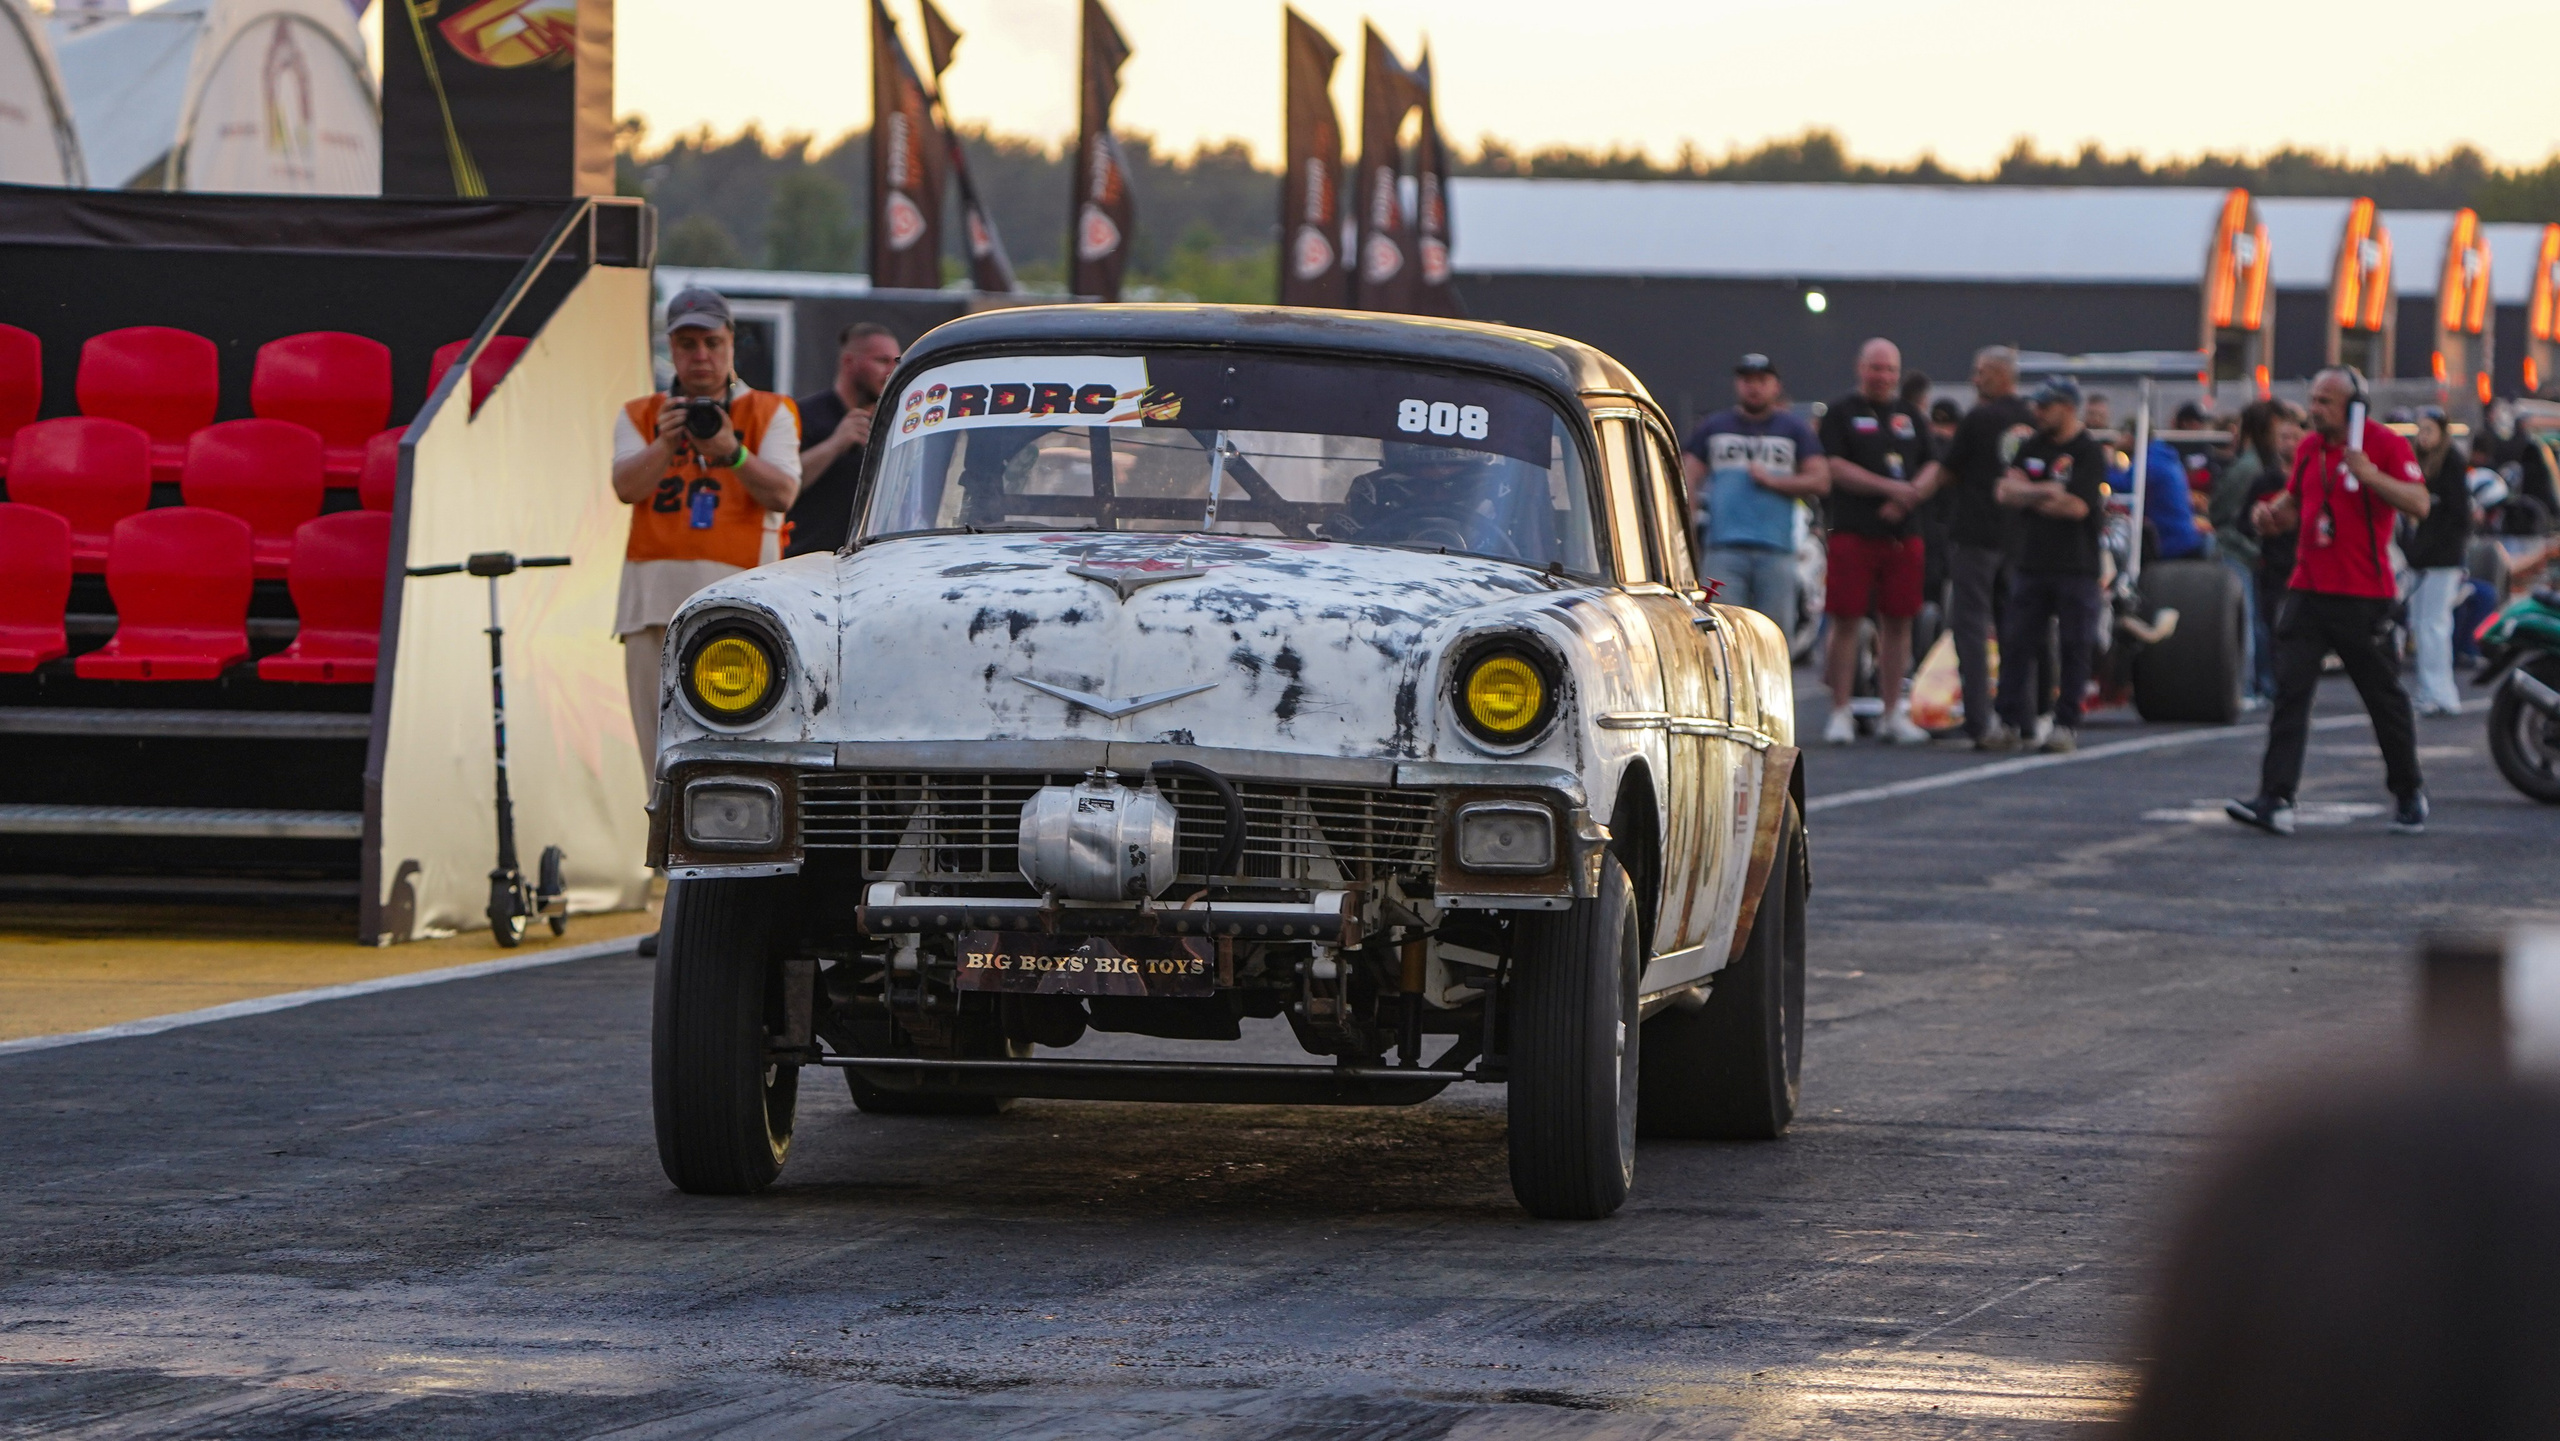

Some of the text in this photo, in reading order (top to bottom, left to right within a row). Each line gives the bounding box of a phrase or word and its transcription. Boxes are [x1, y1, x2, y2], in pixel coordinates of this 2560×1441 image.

[948, 382, 1117, 418] RDRC
[1397, 398, 1489, 440] 808
[966, 952, 1013, 970] BIG
[1094, 957, 1139, 973] BIG
[1145, 958, 1205, 974] TOYS
